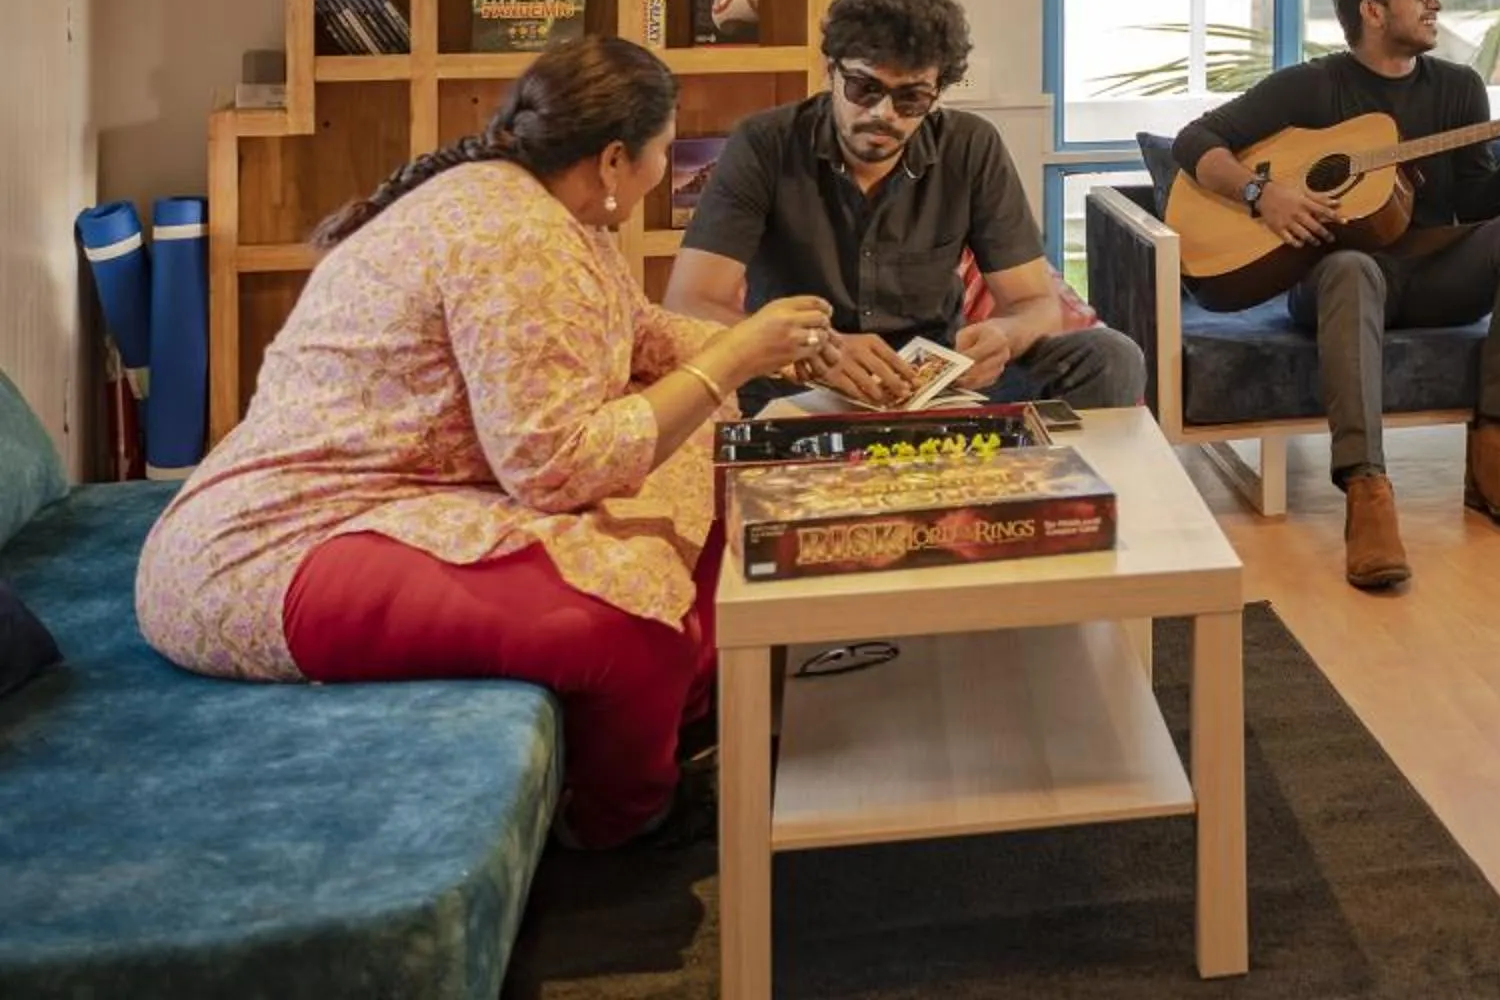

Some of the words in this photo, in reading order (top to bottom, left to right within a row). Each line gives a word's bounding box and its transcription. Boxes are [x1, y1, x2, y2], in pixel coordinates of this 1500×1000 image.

[480, 0, 575, 19] PANDEMIC
[796, 519, 908, 565] RISK
[974, 519, 1035, 545] RINGS
